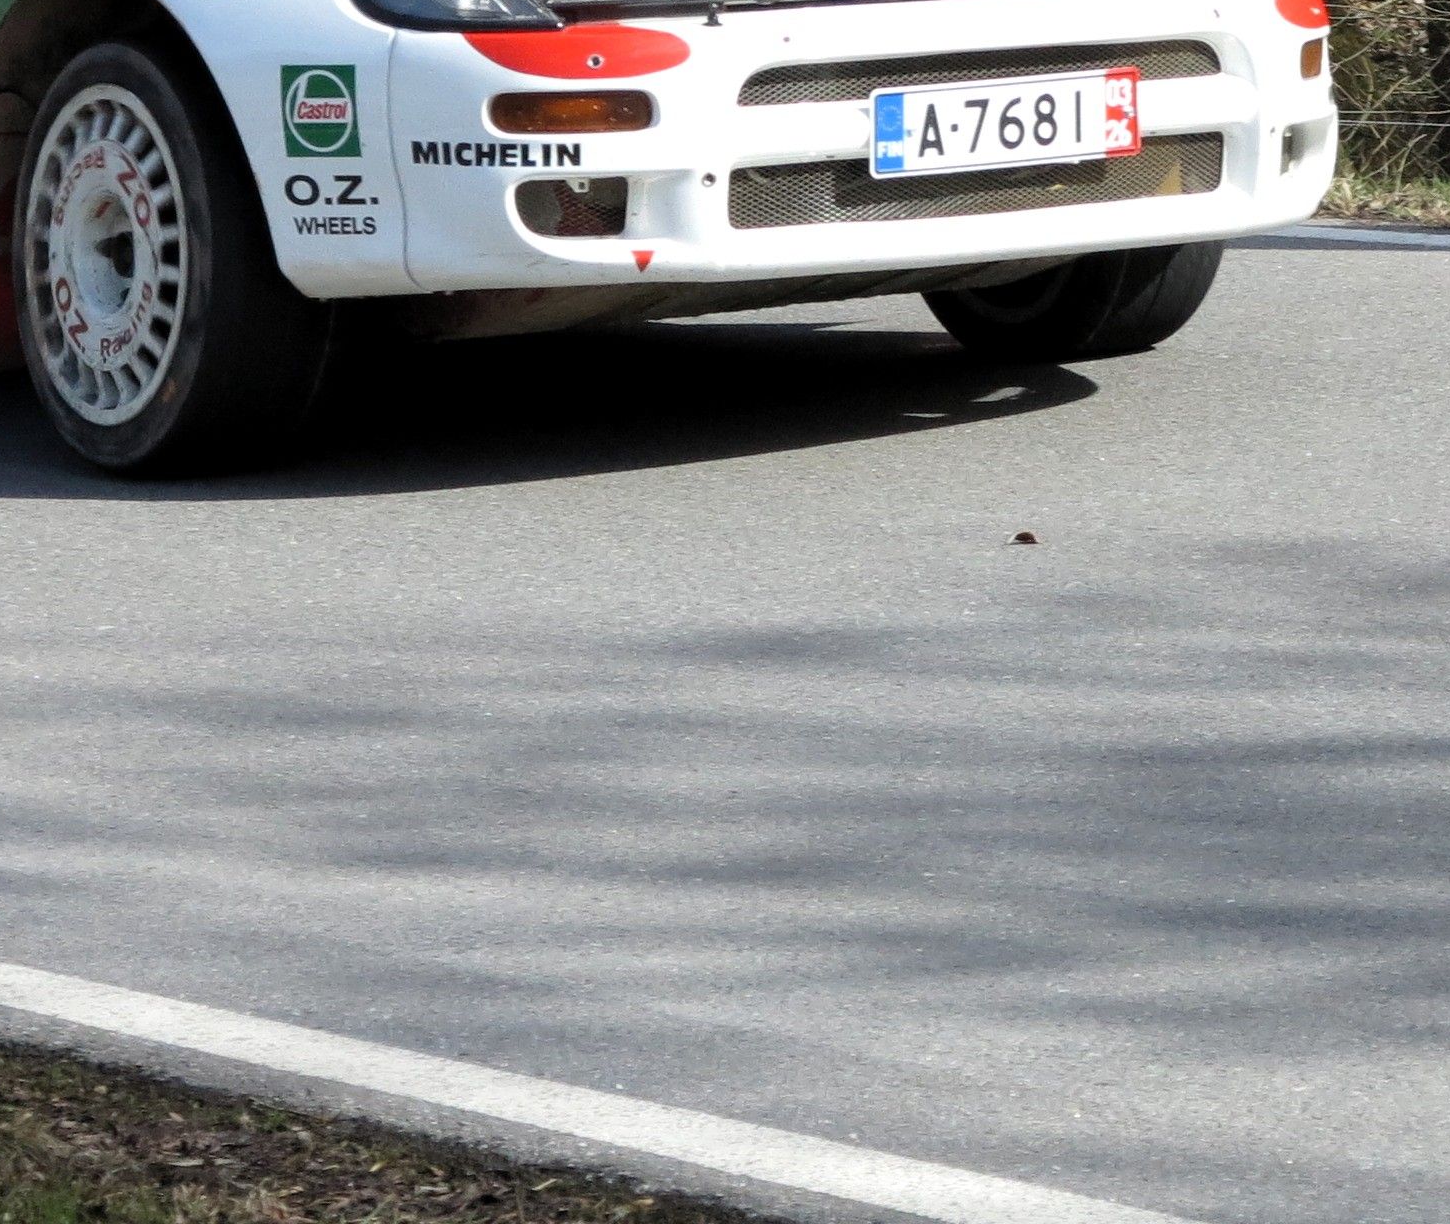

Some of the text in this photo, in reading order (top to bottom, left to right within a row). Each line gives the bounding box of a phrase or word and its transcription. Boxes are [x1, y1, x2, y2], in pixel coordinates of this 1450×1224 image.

[1105, 78, 1132, 107] 03
[297, 101, 348, 120] Castrol
[877, 90, 1081, 158] FIN A-7681
[1105, 120, 1132, 147] 26
[411, 141, 581, 167] MICHELIN
[284, 175, 380, 206] O.Z.
[293, 216, 377, 235] WHEELS
